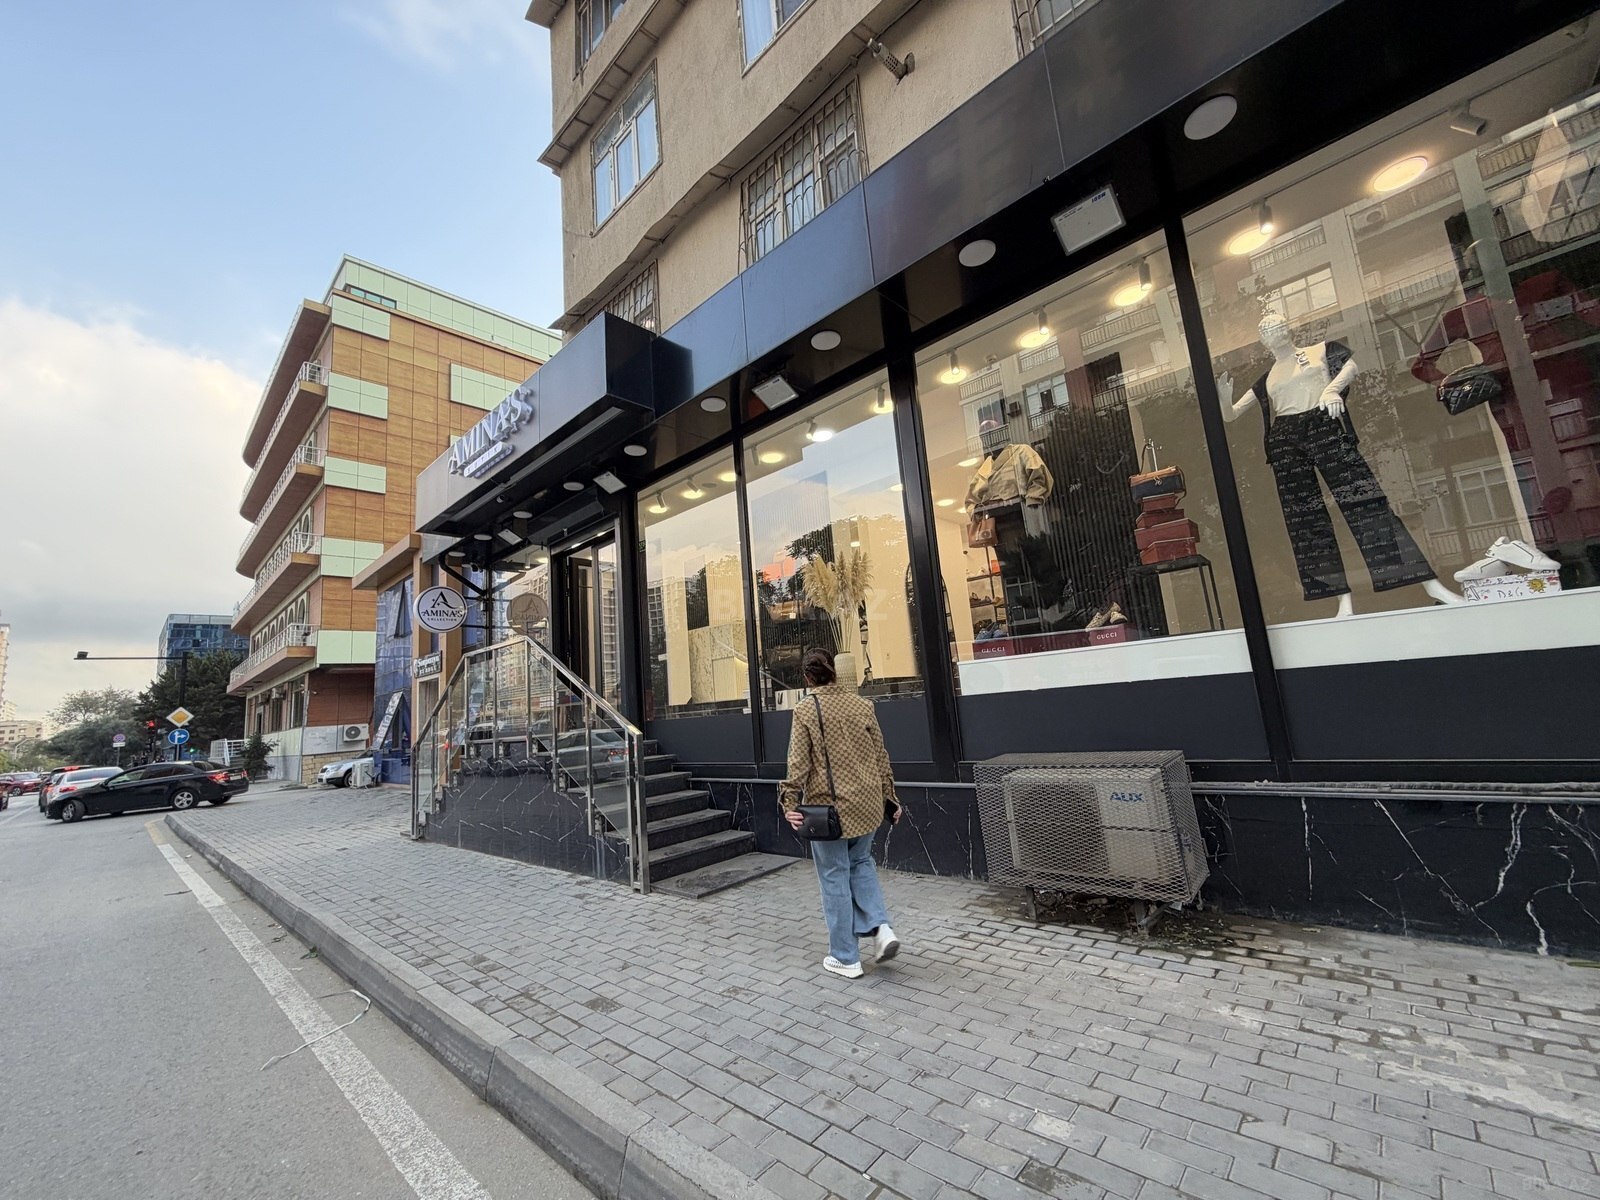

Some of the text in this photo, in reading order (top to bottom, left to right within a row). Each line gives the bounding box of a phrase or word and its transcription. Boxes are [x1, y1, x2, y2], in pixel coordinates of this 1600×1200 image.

[421, 609, 463, 618] AMINA'S
[1096, 632, 1118, 640] GUCCI
[981, 646, 1006, 654] GUCCI
